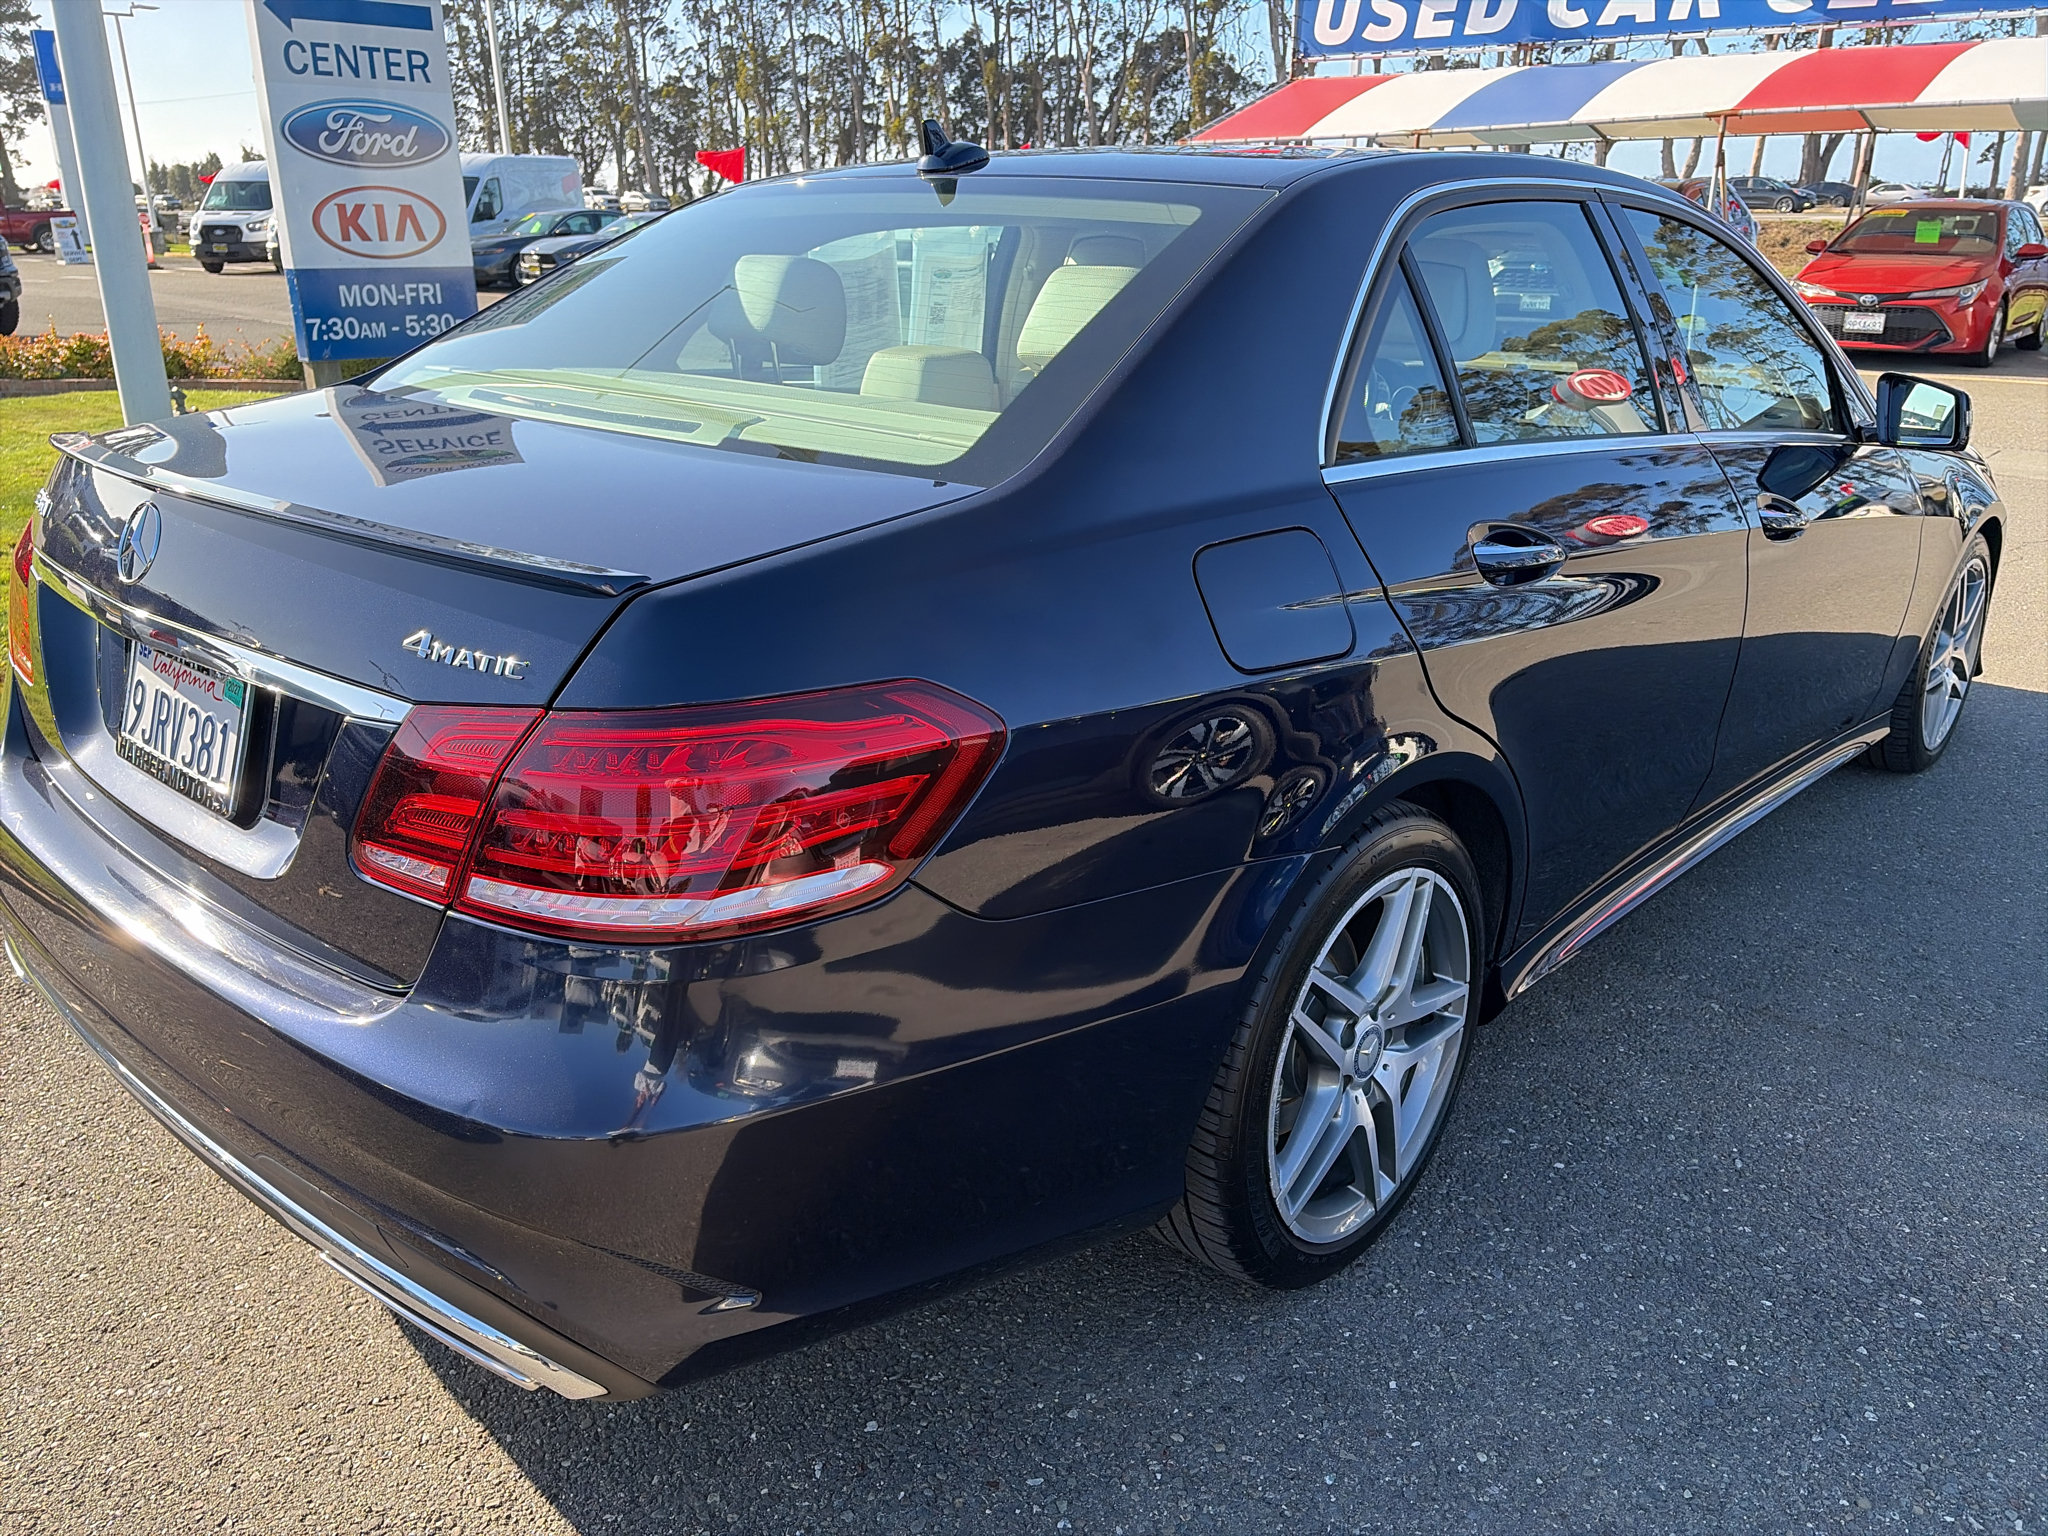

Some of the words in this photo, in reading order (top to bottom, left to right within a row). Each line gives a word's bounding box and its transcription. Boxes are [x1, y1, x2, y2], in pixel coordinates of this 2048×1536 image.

[283, 40, 431, 84] CENTER
[318, 108, 420, 159] Ford
[334, 203, 427, 243] KIA
[338, 283, 443, 308] MON-FRI
[305, 317, 387, 342] 7:30AM
[405, 313, 465, 337] 5:30
[152, 652, 223, 702] California
[401, 629, 531, 681] 4MATIC
[127, 678, 231, 782] 9JRV381
[118, 737, 166, 779] HARPER
